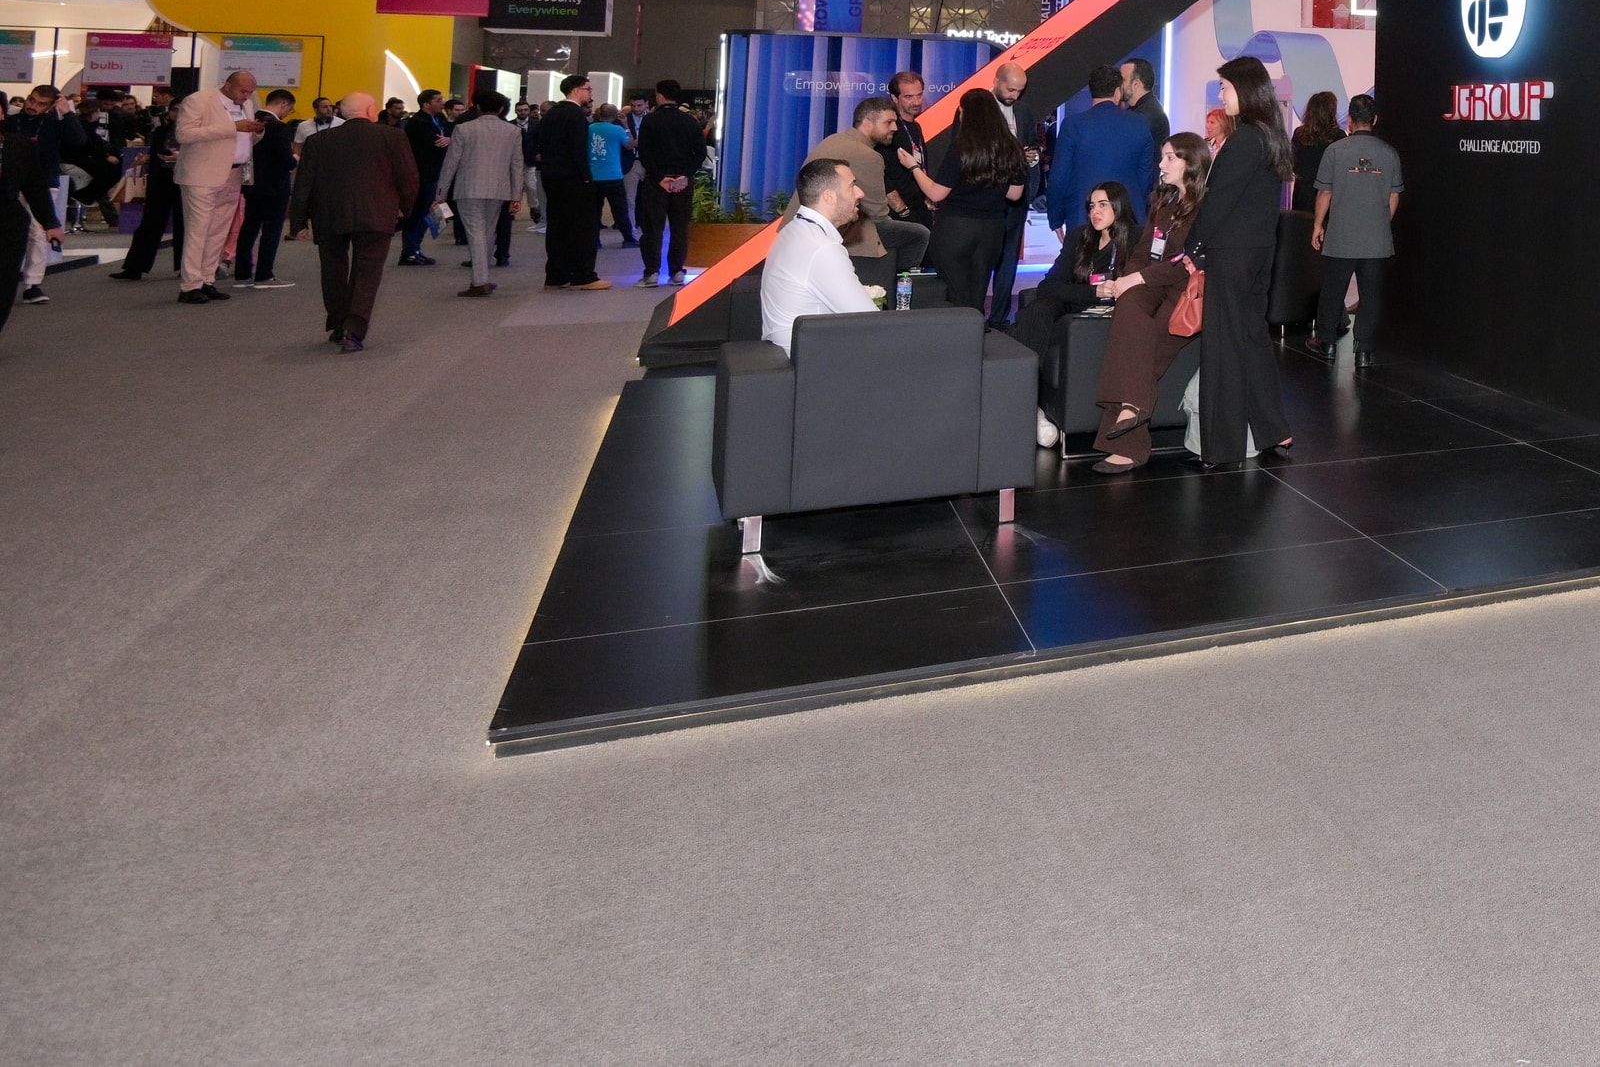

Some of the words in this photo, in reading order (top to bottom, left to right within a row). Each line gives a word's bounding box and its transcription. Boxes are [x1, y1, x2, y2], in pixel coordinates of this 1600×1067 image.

[508, 4, 579, 16] Everywhere
[90, 61, 124, 70] bulbi
[795, 78, 875, 93] Empowering
[1441, 81, 1554, 121] JGROUP
[1460, 139, 1500, 153] CHALLENGE
[1501, 140, 1541, 154] ACCEPTED
